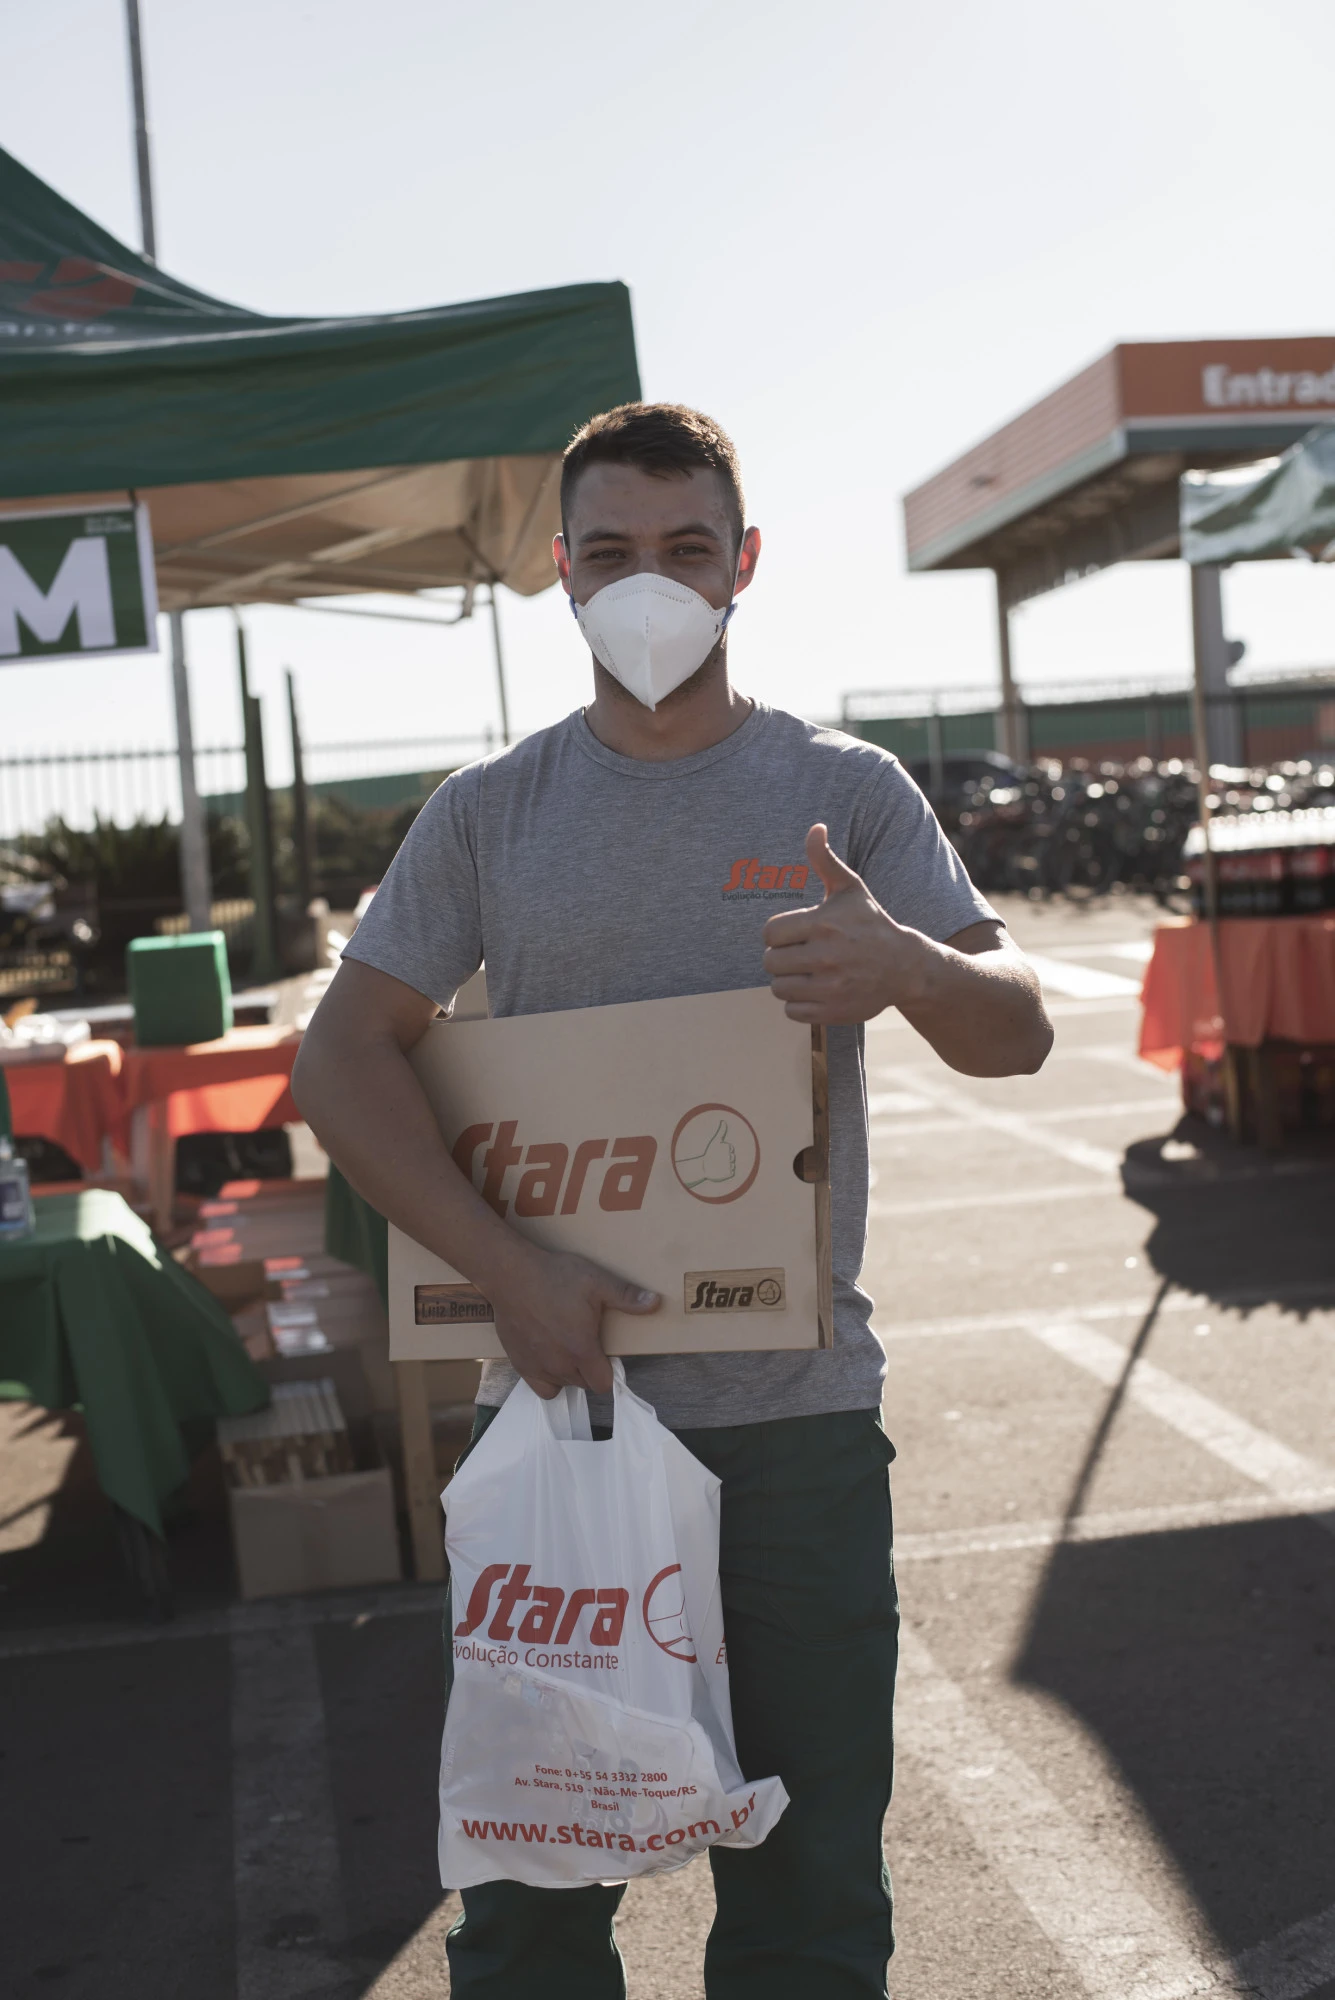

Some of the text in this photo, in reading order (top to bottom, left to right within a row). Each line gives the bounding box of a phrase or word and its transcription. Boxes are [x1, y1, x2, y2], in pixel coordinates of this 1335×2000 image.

[722, 857, 809, 891] Stara
[762, 890, 804, 901] Constante
[689, 1280, 755, 1310] Stara
[454, 1563, 630, 1647] Stara
[452, 1640, 619, 1670] volução Constante
[514, 1777, 531, 1787] Av.
[533, 1778, 563, 1792] Stara,
[565, 1783, 584, 1794] 519
[593, 1785, 698, 1800] Não-Me-Toque/RS
[535, 1764, 668, 1783] Fone: 0+55 54 3332 2800
[591, 1800, 620, 1812] Brasil
[461, 1792, 757, 1853] www.stara.com.br
